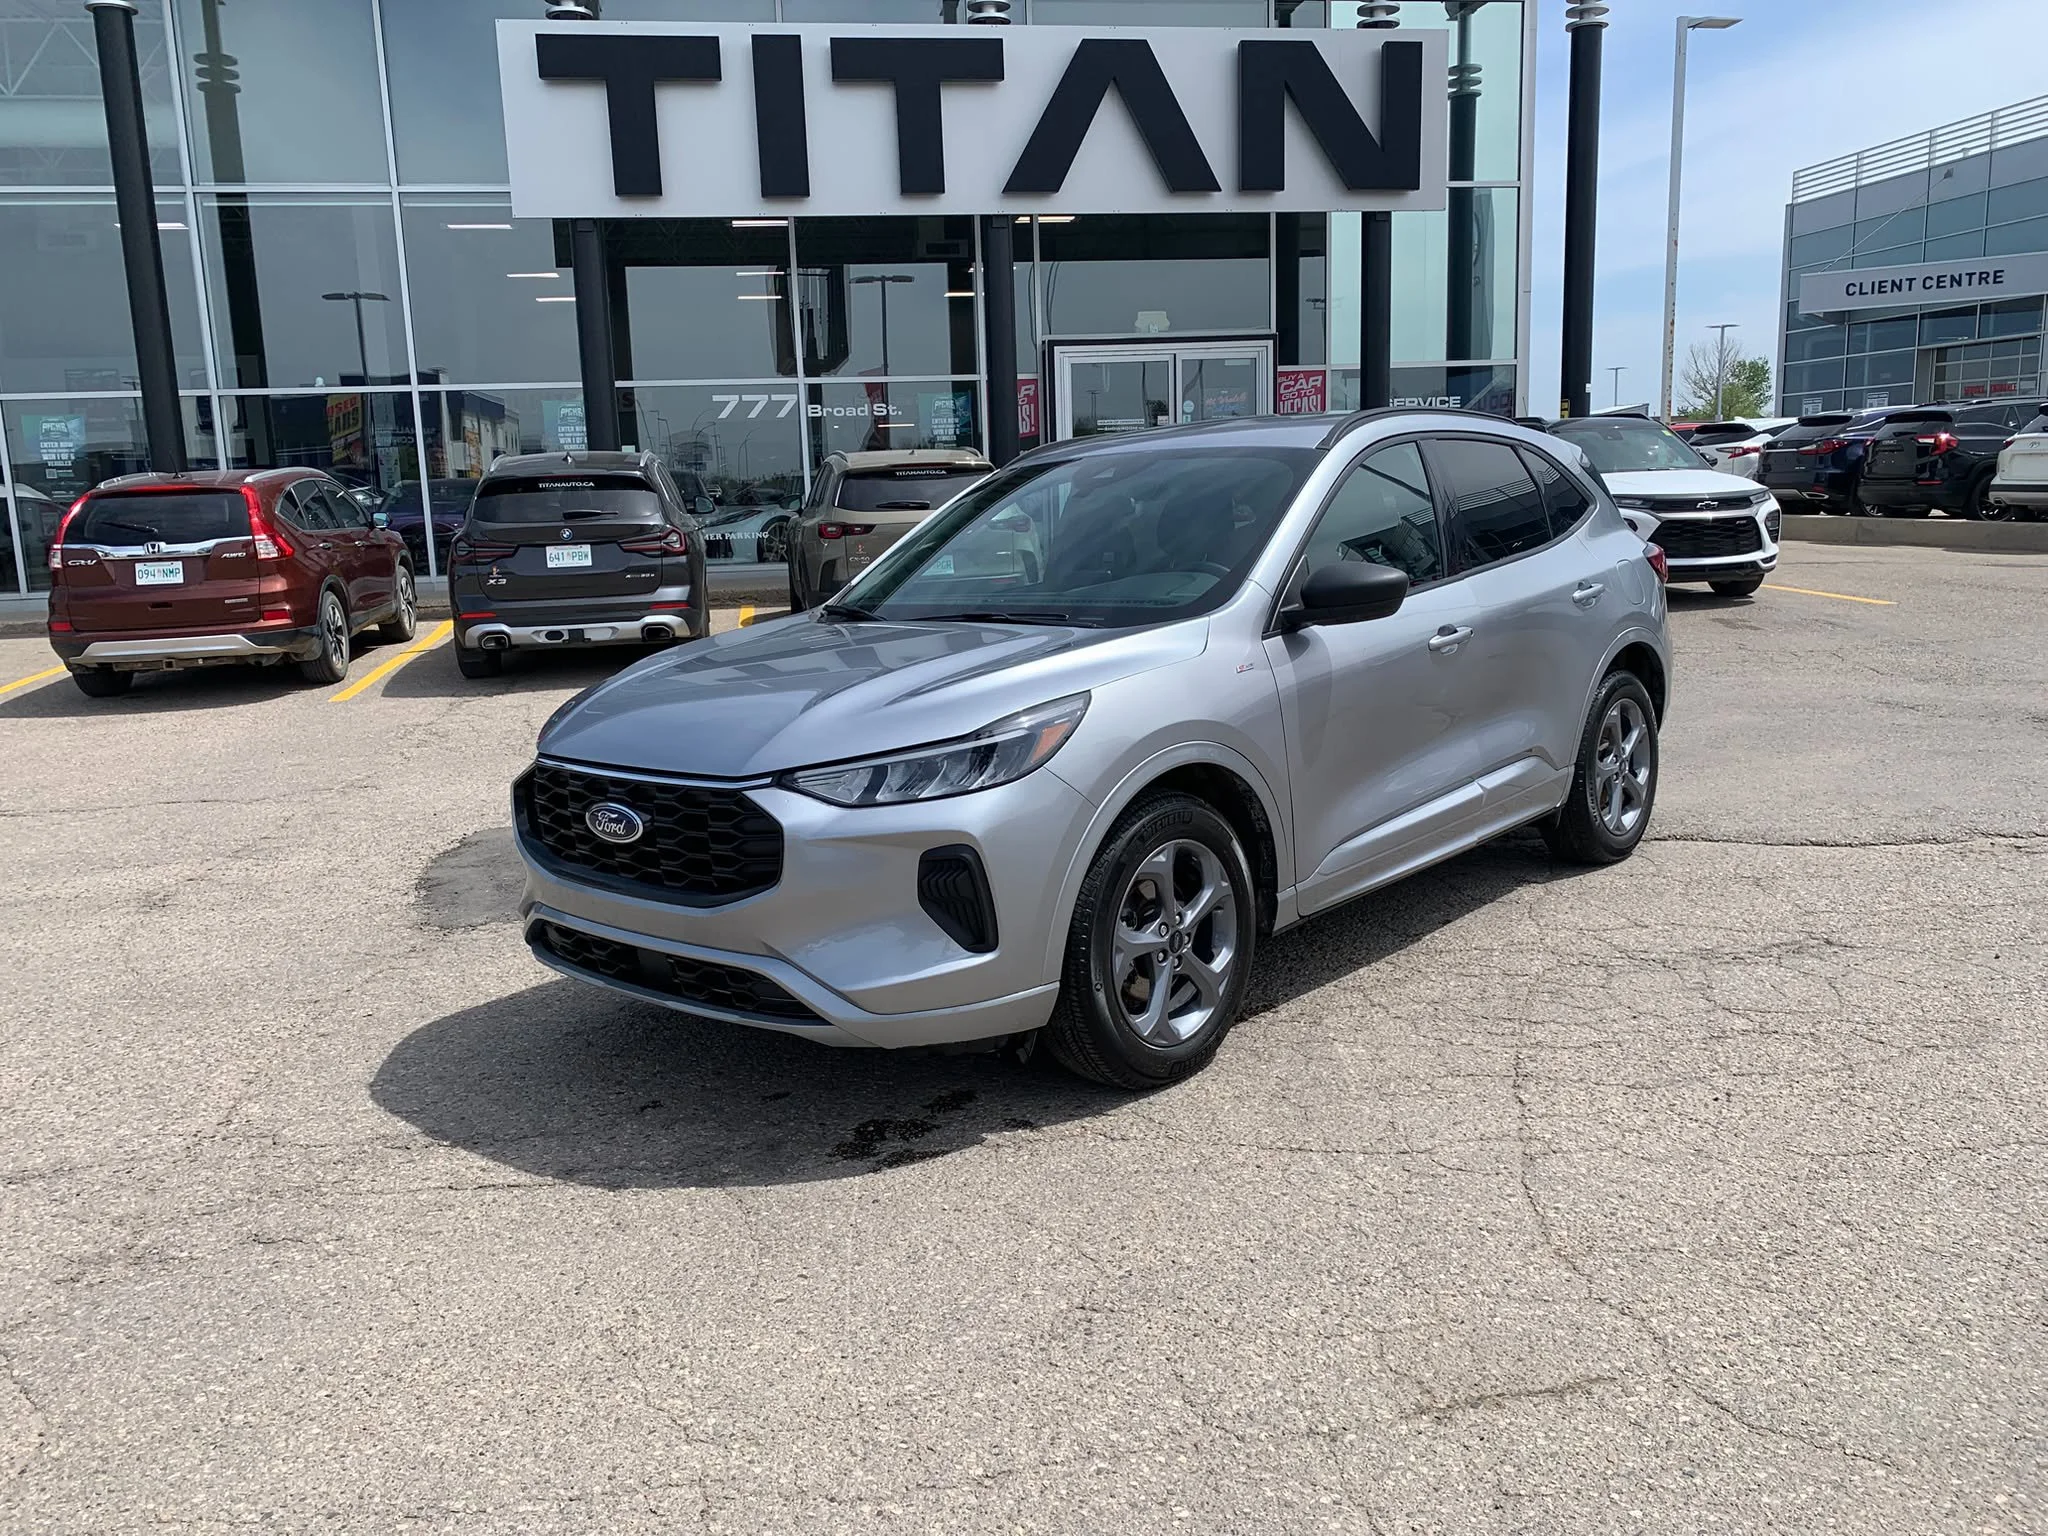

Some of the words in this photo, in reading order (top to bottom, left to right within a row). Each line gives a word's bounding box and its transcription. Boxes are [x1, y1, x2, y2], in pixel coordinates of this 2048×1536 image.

[534, 33, 1423, 198] TITAN
[1845, 277, 1917, 297] CLIENT
[1921, 269, 2005, 290] CENTRE
[1279, 375, 1323, 394] CAR
[1281, 392, 1298, 400] GO
[1299, 388, 1316, 397] TO
[711, 394, 798, 419] 777
[807, 404, 869, 417] Broad
[872, 403, 903, 416] St.
[1389, 395, 1462, 408] ERVICE
[725, 531, 769, 540] PARKING
[549, 551, 565, 563] 641
[137, 568, 156, 580] 094
[162, 567, 181, 579] NMP
[487, 578, 506, 586] X3
[595, 810, 627, 835] Ford
